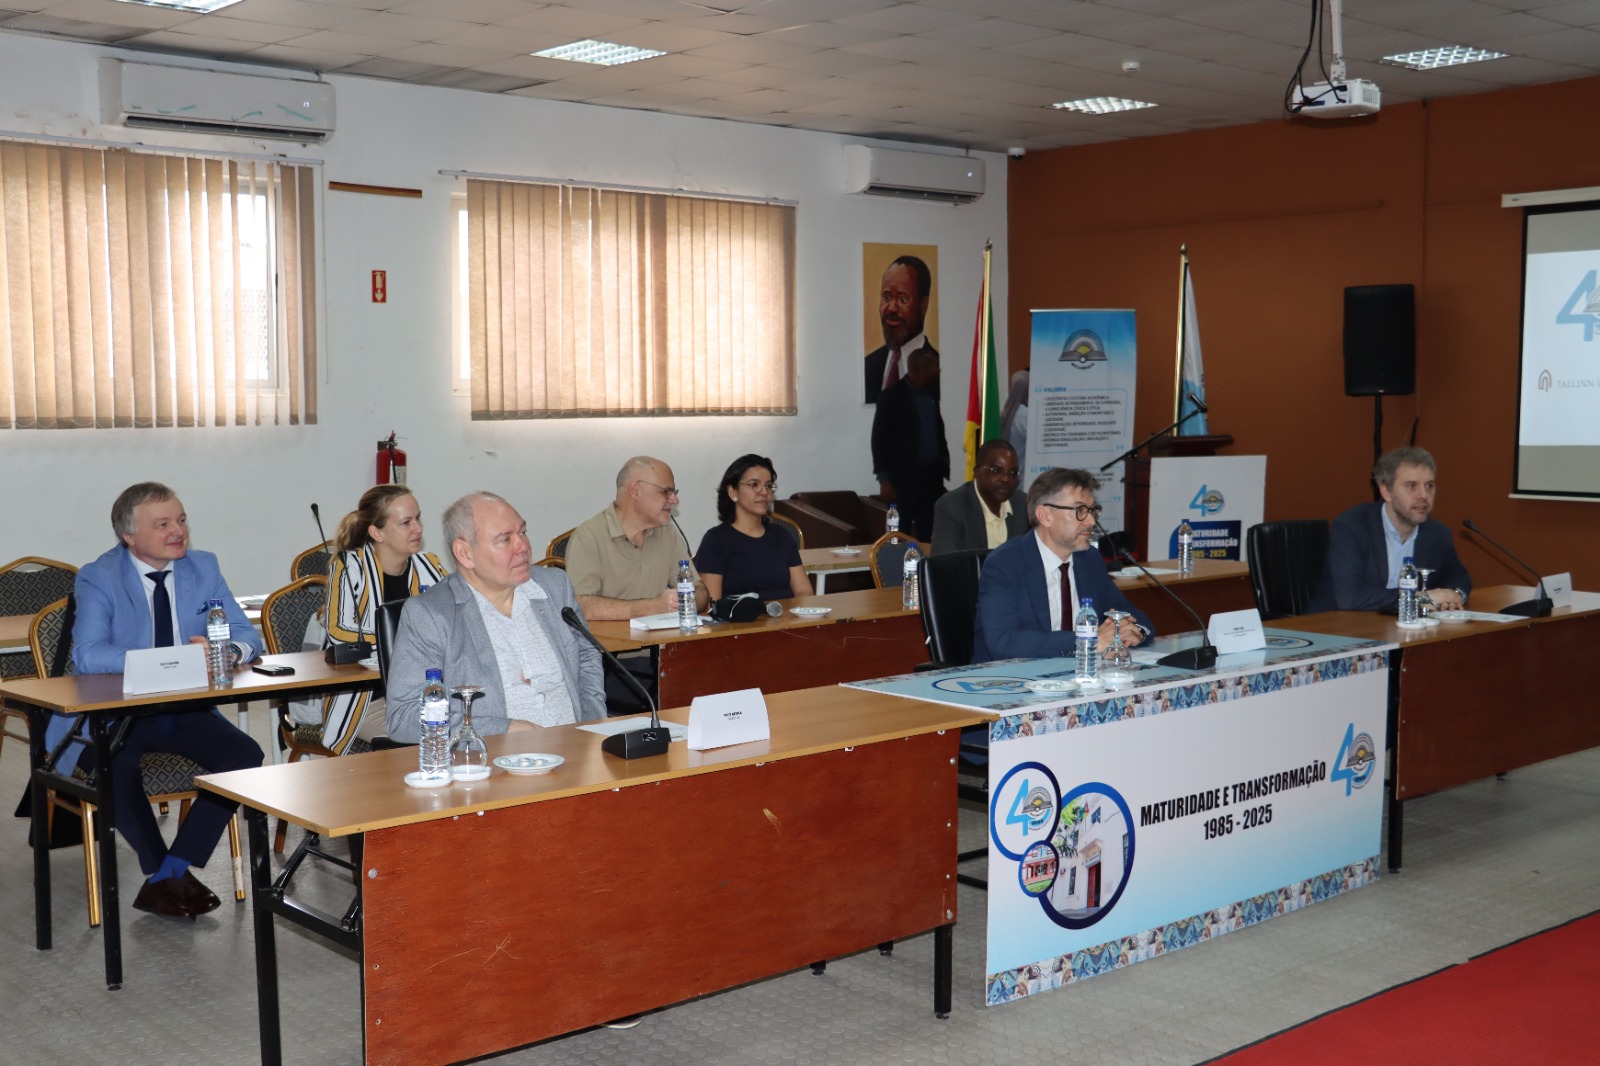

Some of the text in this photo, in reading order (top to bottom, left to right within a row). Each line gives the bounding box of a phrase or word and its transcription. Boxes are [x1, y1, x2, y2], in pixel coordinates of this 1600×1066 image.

[1557, 379, 1594, 389] TALLINN
[1192, 529, 1228, 538] ATURIDADE
[1210, 549, 1226, 558] 2025
[1140, 760, 1327, 827] MATURIDADE E TRANSFORMAÇÃO
[1203, 814, 1233, 840] 1985
[1243, 803, 1273, 830] 2025
